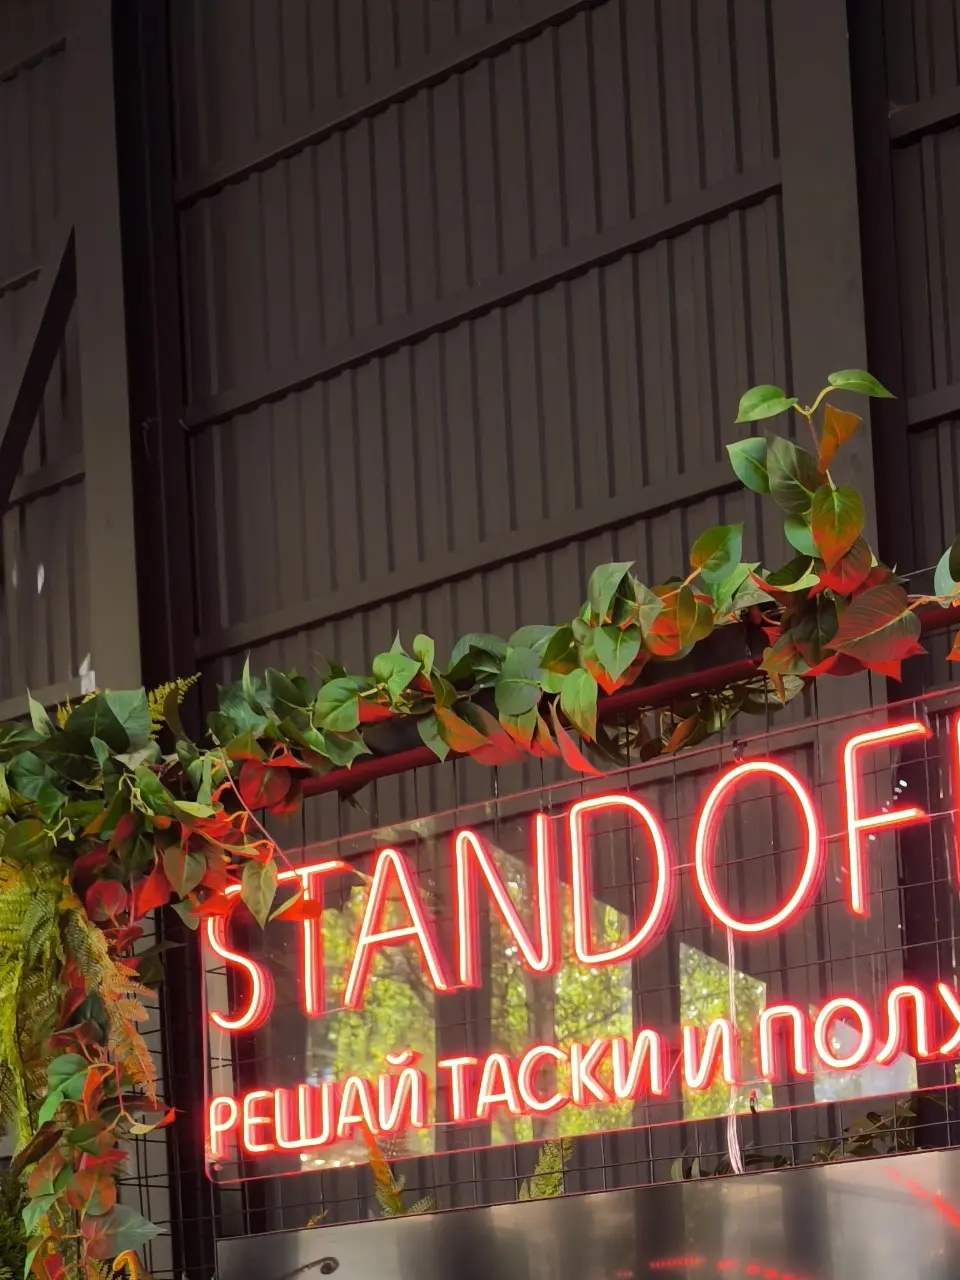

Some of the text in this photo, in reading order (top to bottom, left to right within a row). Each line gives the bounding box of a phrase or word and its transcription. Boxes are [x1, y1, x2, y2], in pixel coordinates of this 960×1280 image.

[207, 1050, 425, 1157] РЕШАЙ
[438, 1028, 668, 1121] ТАСКИ
[682, 1017, 737, 1090] И
